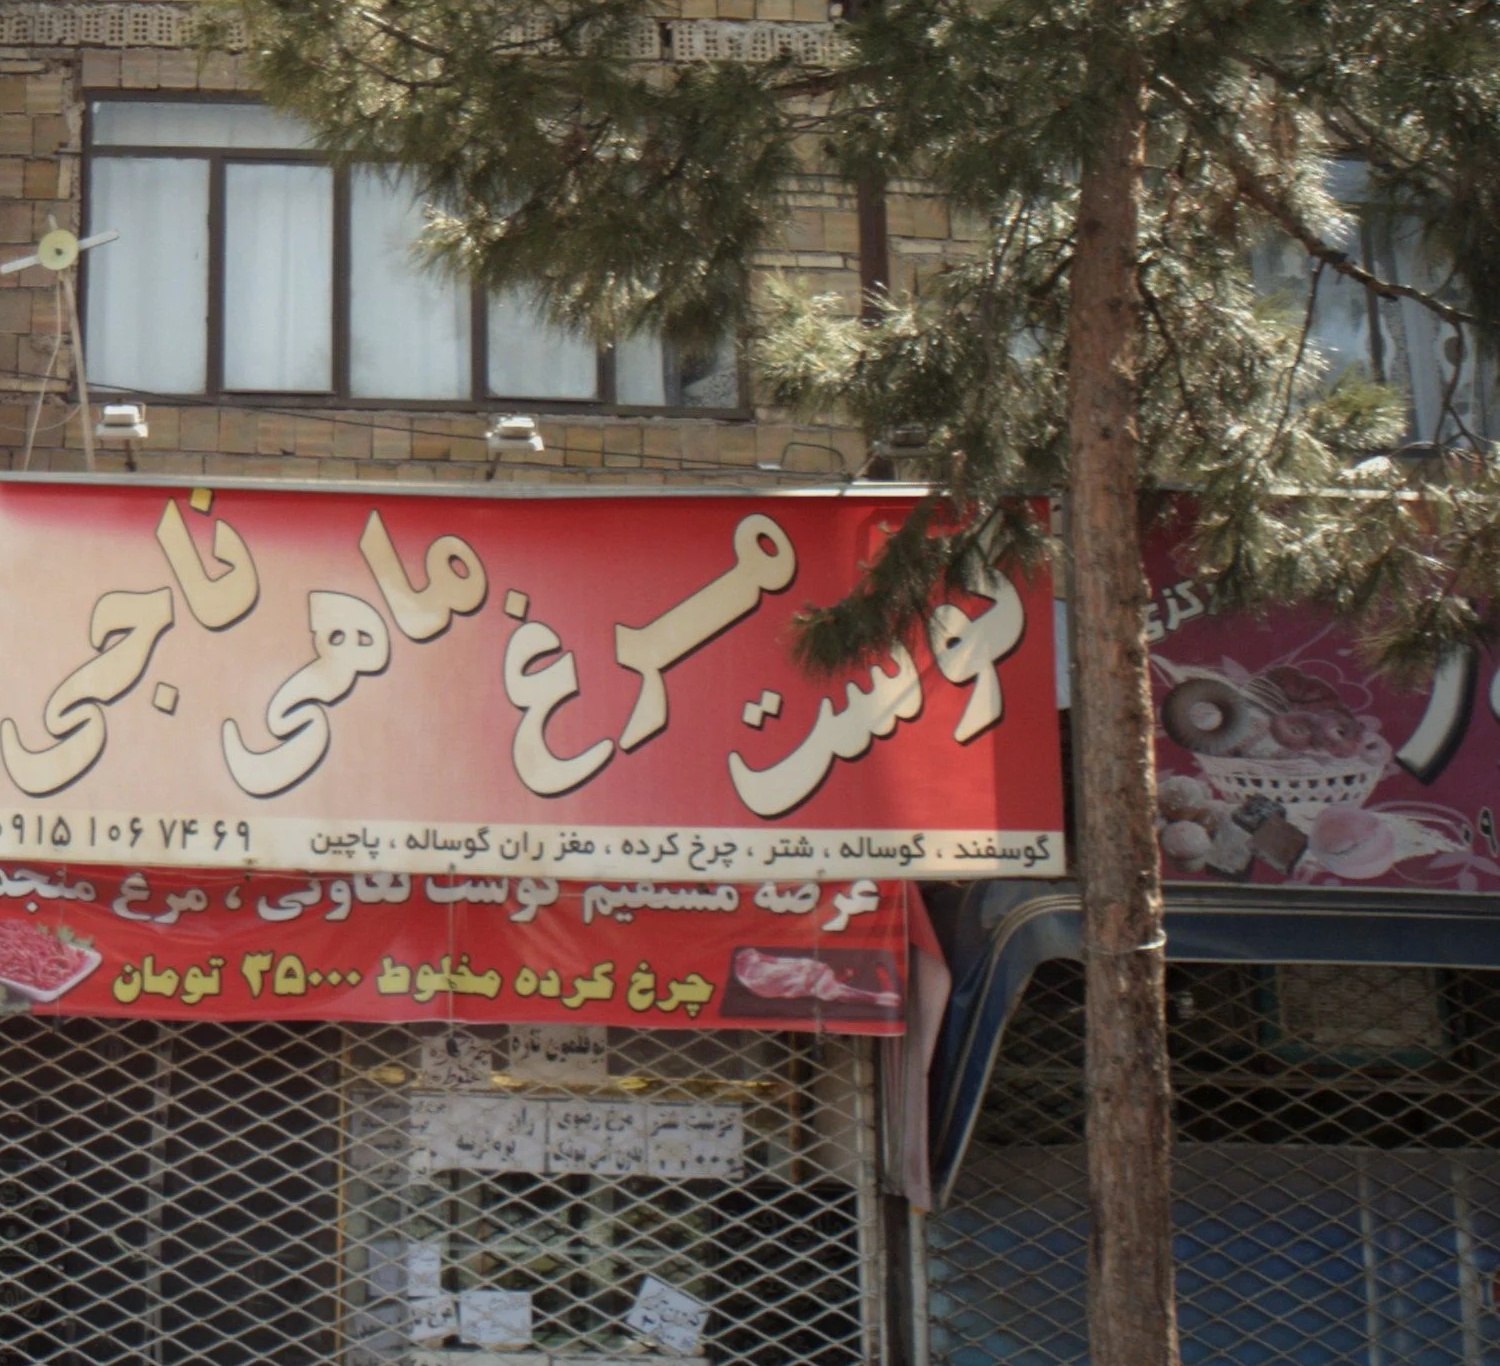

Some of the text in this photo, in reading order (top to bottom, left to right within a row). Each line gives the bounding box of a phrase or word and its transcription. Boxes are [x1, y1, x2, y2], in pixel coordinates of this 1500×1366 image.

[0, 486, 260, 799] ناجی
[221, 508, 488, 799] ماهی
[503, 512, 797, 799] مرغ
[310, 827, 380, 859] پاچین
[405, 826, 490, 861] گوساله
[499, 830, 544, 861] ران
[554, 831, 595, 861] مغز
[621, 833, 678, 866] کرده
[687, 834, 738, 871] چرخ
[763, 831, 814, 867] شتر
[839, 832, 926, 867] گوساله
[953, 830, 1051, 868] گوسفند
[111, 872, 209, 924] مرغ
[111, 952, 226, 1004] تومان
[376, 952, 502, 1003] مخلوط
[513, 960, 615, 1010] کرده
[625, 959, 716, 1018] چرخ
